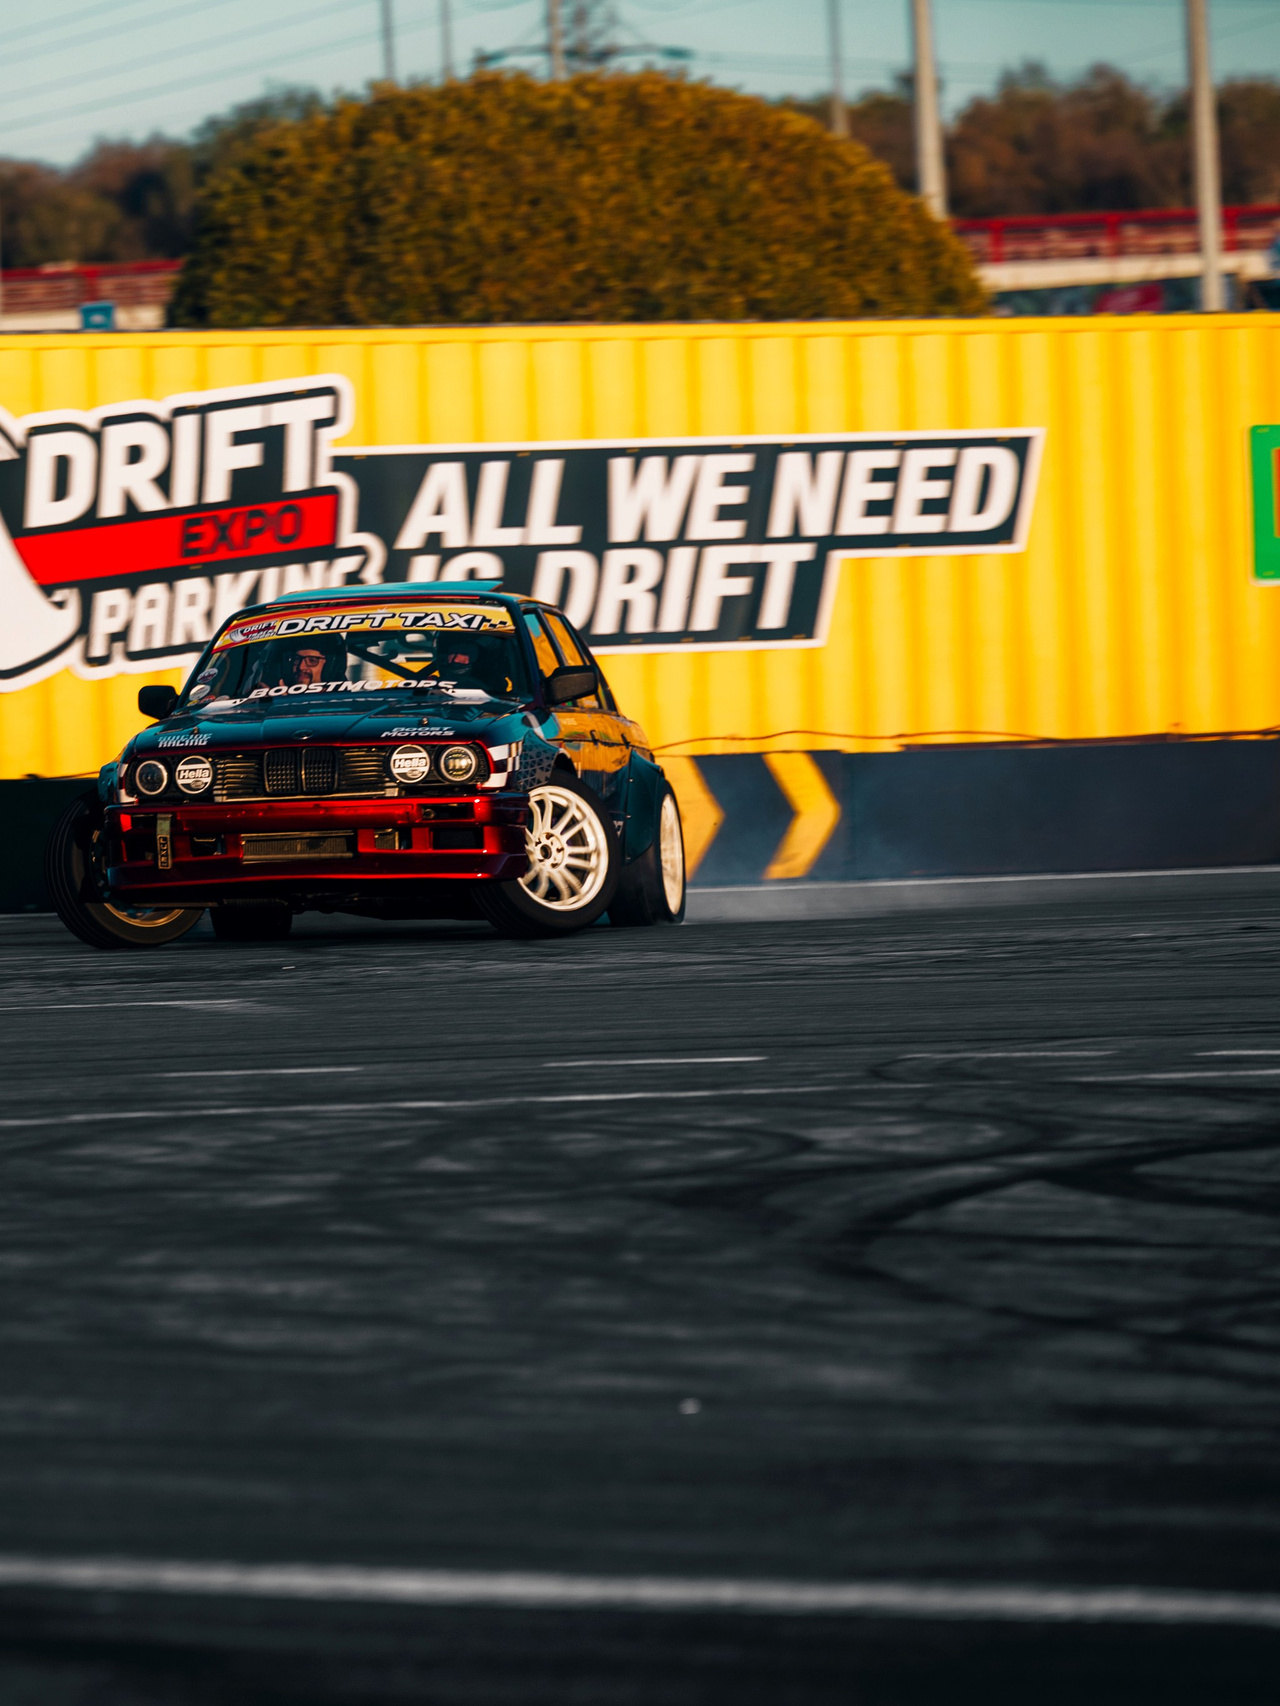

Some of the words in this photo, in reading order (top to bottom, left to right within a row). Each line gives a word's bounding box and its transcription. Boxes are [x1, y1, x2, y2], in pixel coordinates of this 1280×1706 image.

[25, 394, 335, 528] DRIFT
[394, 459, 583, 549] ALL
[608, 451, 756, 543] WE
[767, 445, 1020, 539] NEED
[181, 503, 303, 558] EXPO
[532, 543, 817, 636] DRIFT
[276, 612, 395, 636] DRIFT
[399, 611, 486, 630] TAXI
[248, 679, 458, 699] BOOSTMOTORS
[380, 730, 456, 738] MOTORS
[179, 768, 210, 779] Hella
[395, 757, 427, 768] Hella
